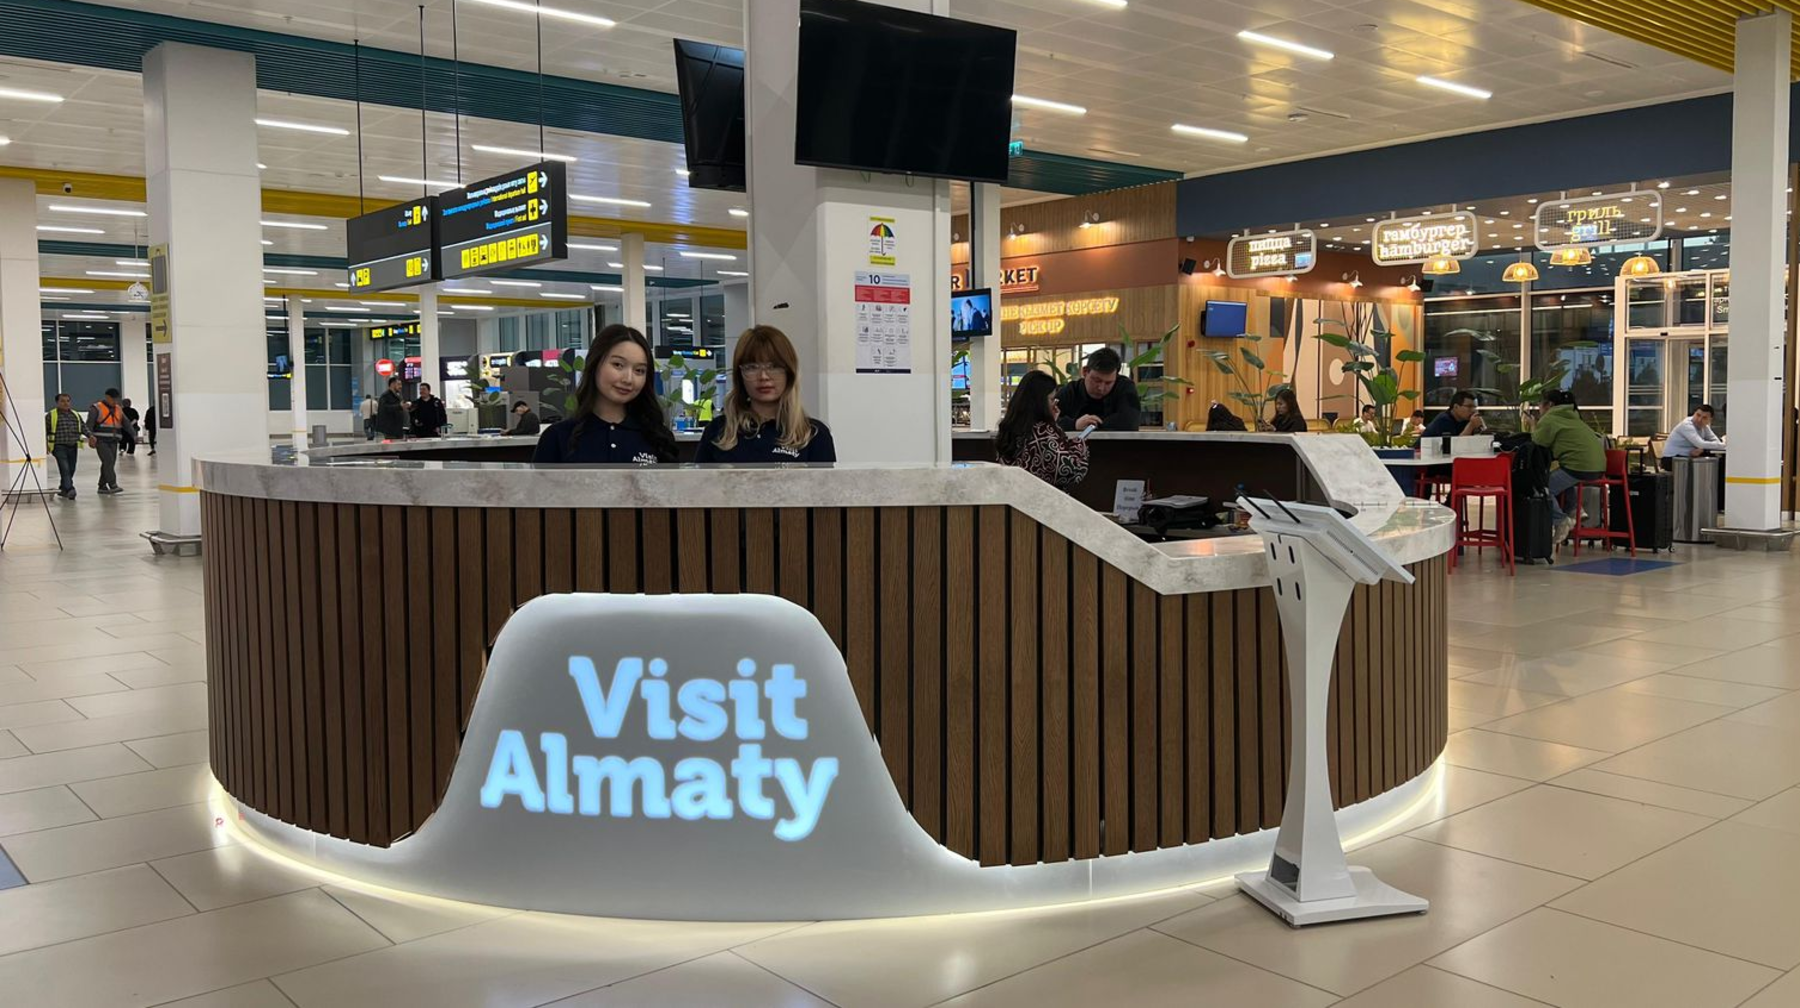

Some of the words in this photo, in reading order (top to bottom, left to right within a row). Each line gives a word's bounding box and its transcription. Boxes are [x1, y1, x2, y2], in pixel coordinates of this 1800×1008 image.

[1567, 205, 1622, 225] гриль
[1382, 222, 1467, 242] гамбургер
[1571, 220, 1611, 243] grill
[1248, 237, 1293, 252] пицца
[1378, 238, 1470, 256] hamburger
[1249, 252, 1287, 270] pizza
[869, 274, 881, 285] 10
[568, 656, 808, 741] Visit
[480, 730, 839, 841] Almaty
